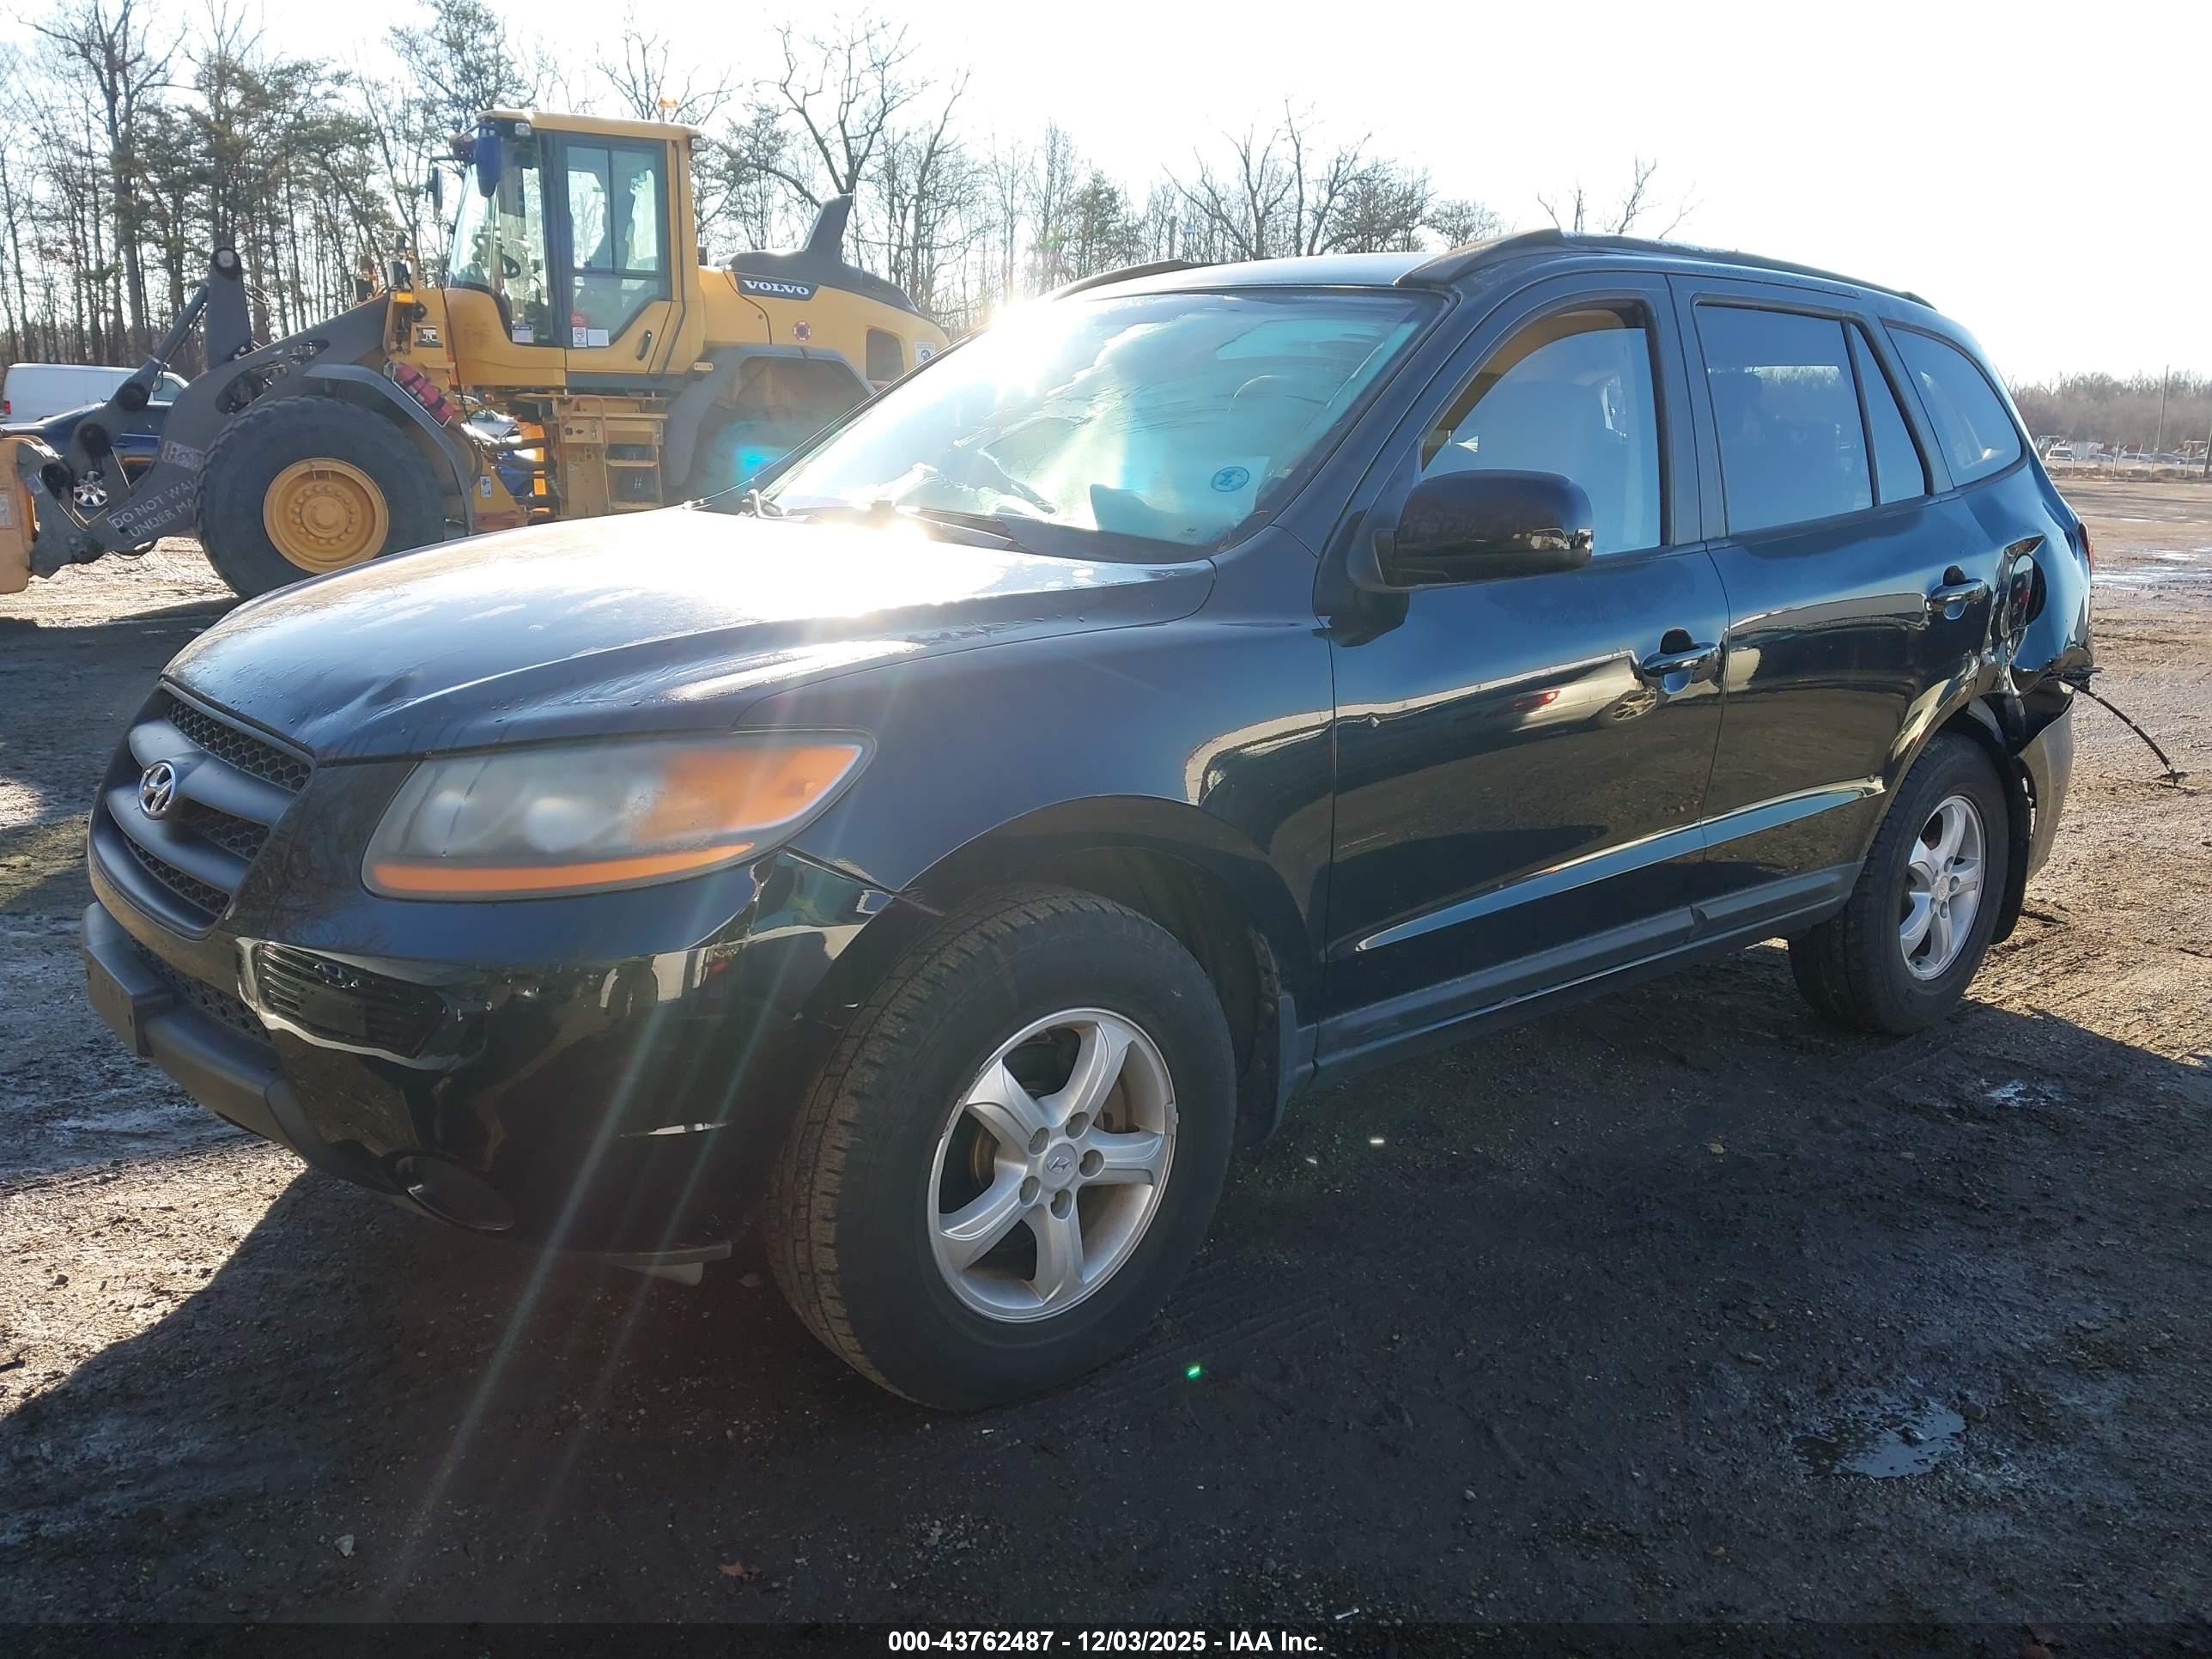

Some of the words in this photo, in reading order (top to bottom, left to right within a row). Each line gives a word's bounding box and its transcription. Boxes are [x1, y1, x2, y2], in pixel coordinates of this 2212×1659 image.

[742, 279, 810, 296] VOLVO
[112, 513, 134, 529] DO
[136, 495, 164, 516] NOT
[129, 509, 176, 538] UNDER
